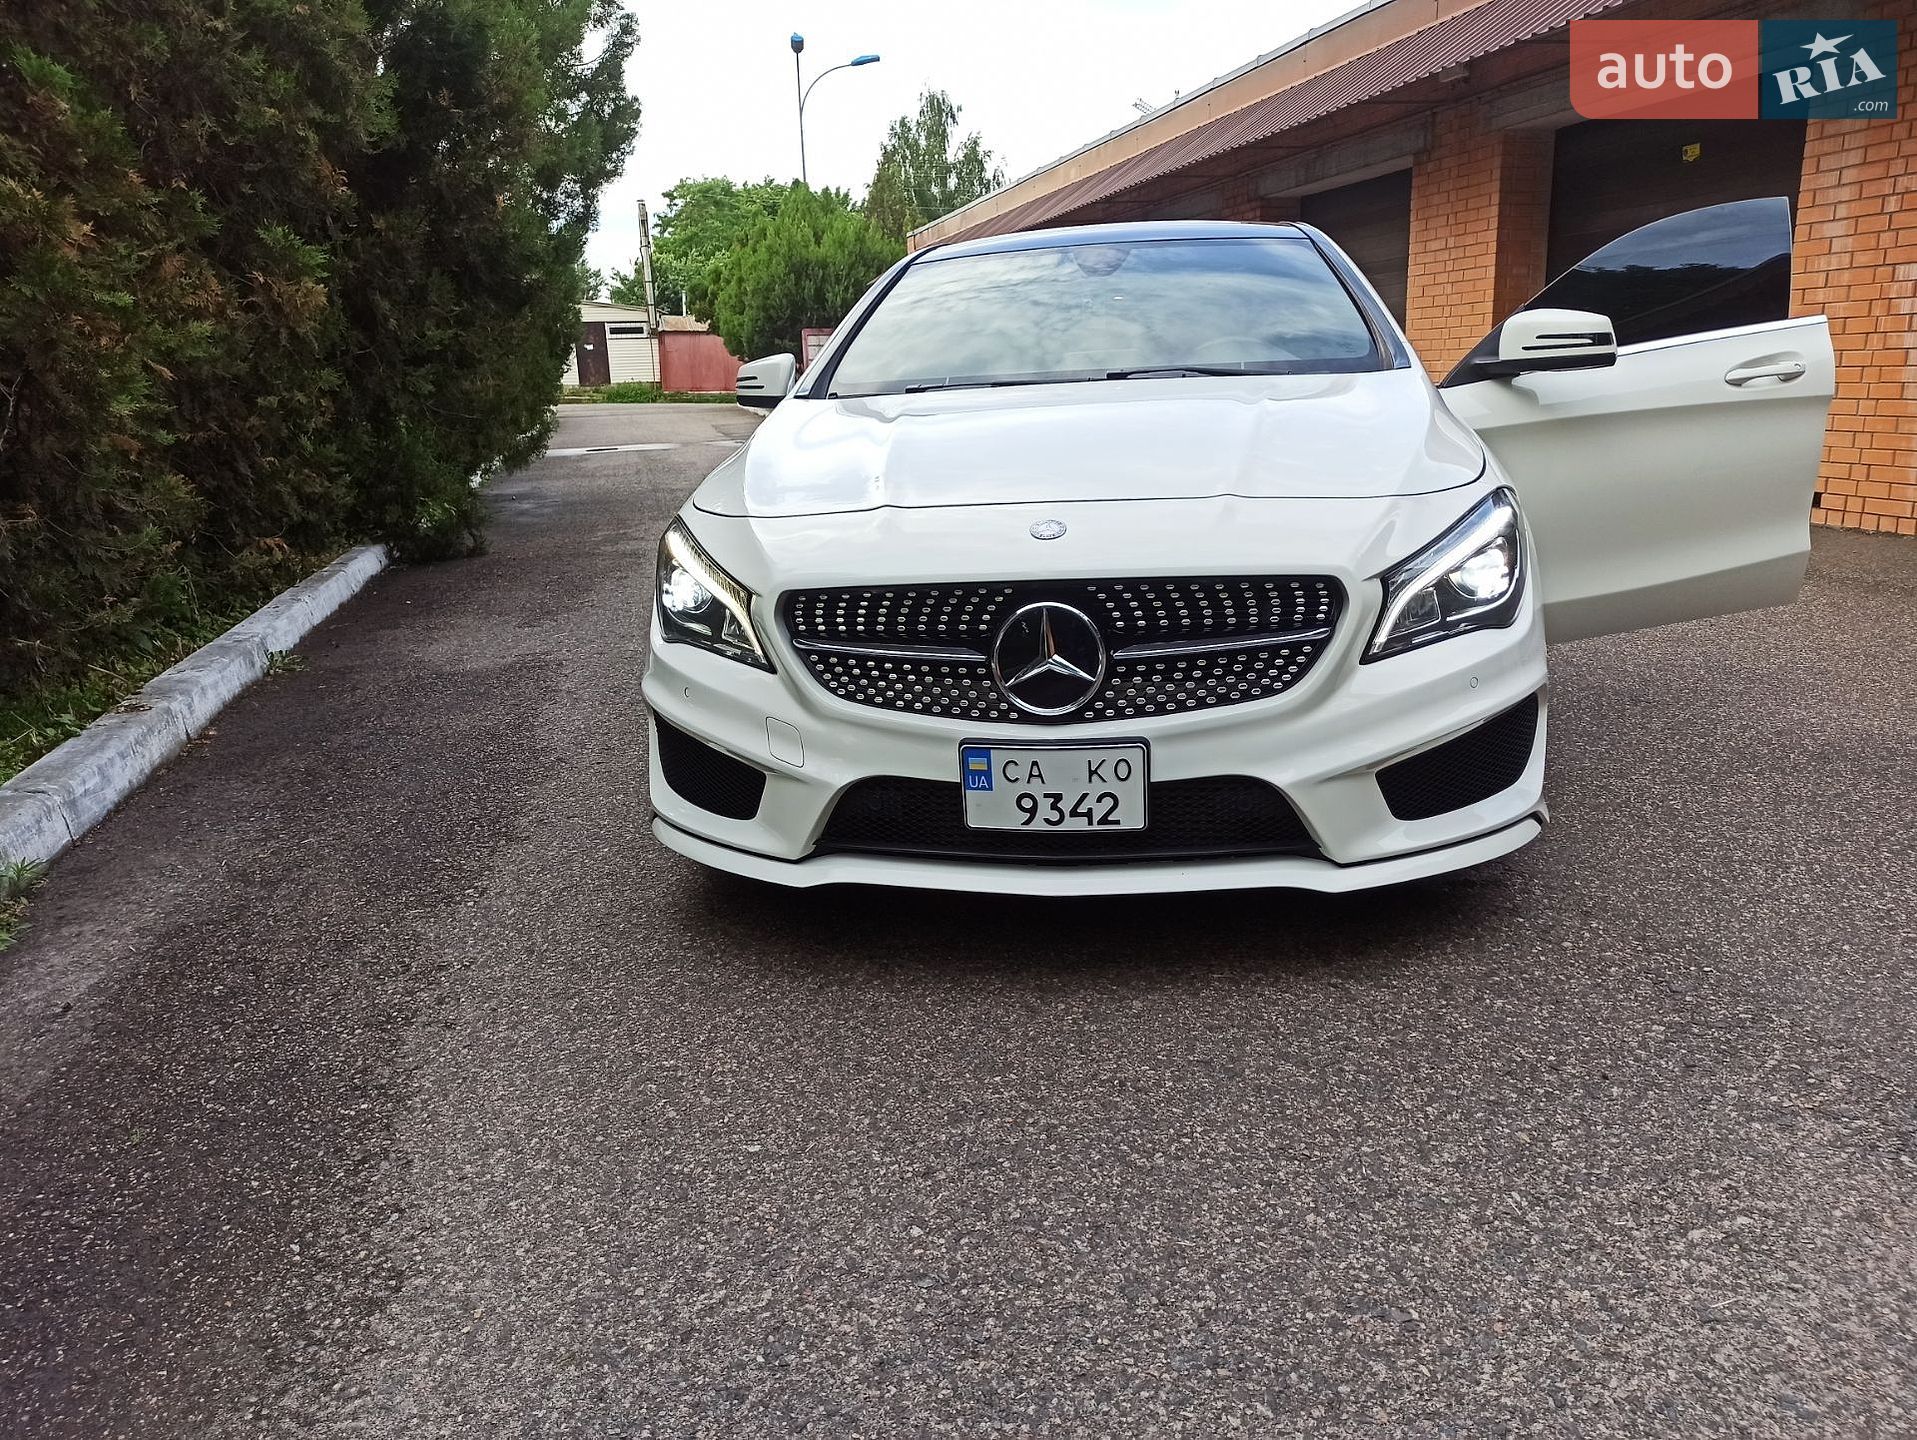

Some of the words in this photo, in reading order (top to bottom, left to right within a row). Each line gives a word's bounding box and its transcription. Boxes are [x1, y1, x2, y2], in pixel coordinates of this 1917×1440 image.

[968, 775, 989, 788] UA
[1002, 759, 1046, 785] CA
[1087, 757, 1132, 784] KO
[1015, 791, 1121, 827] 9342
